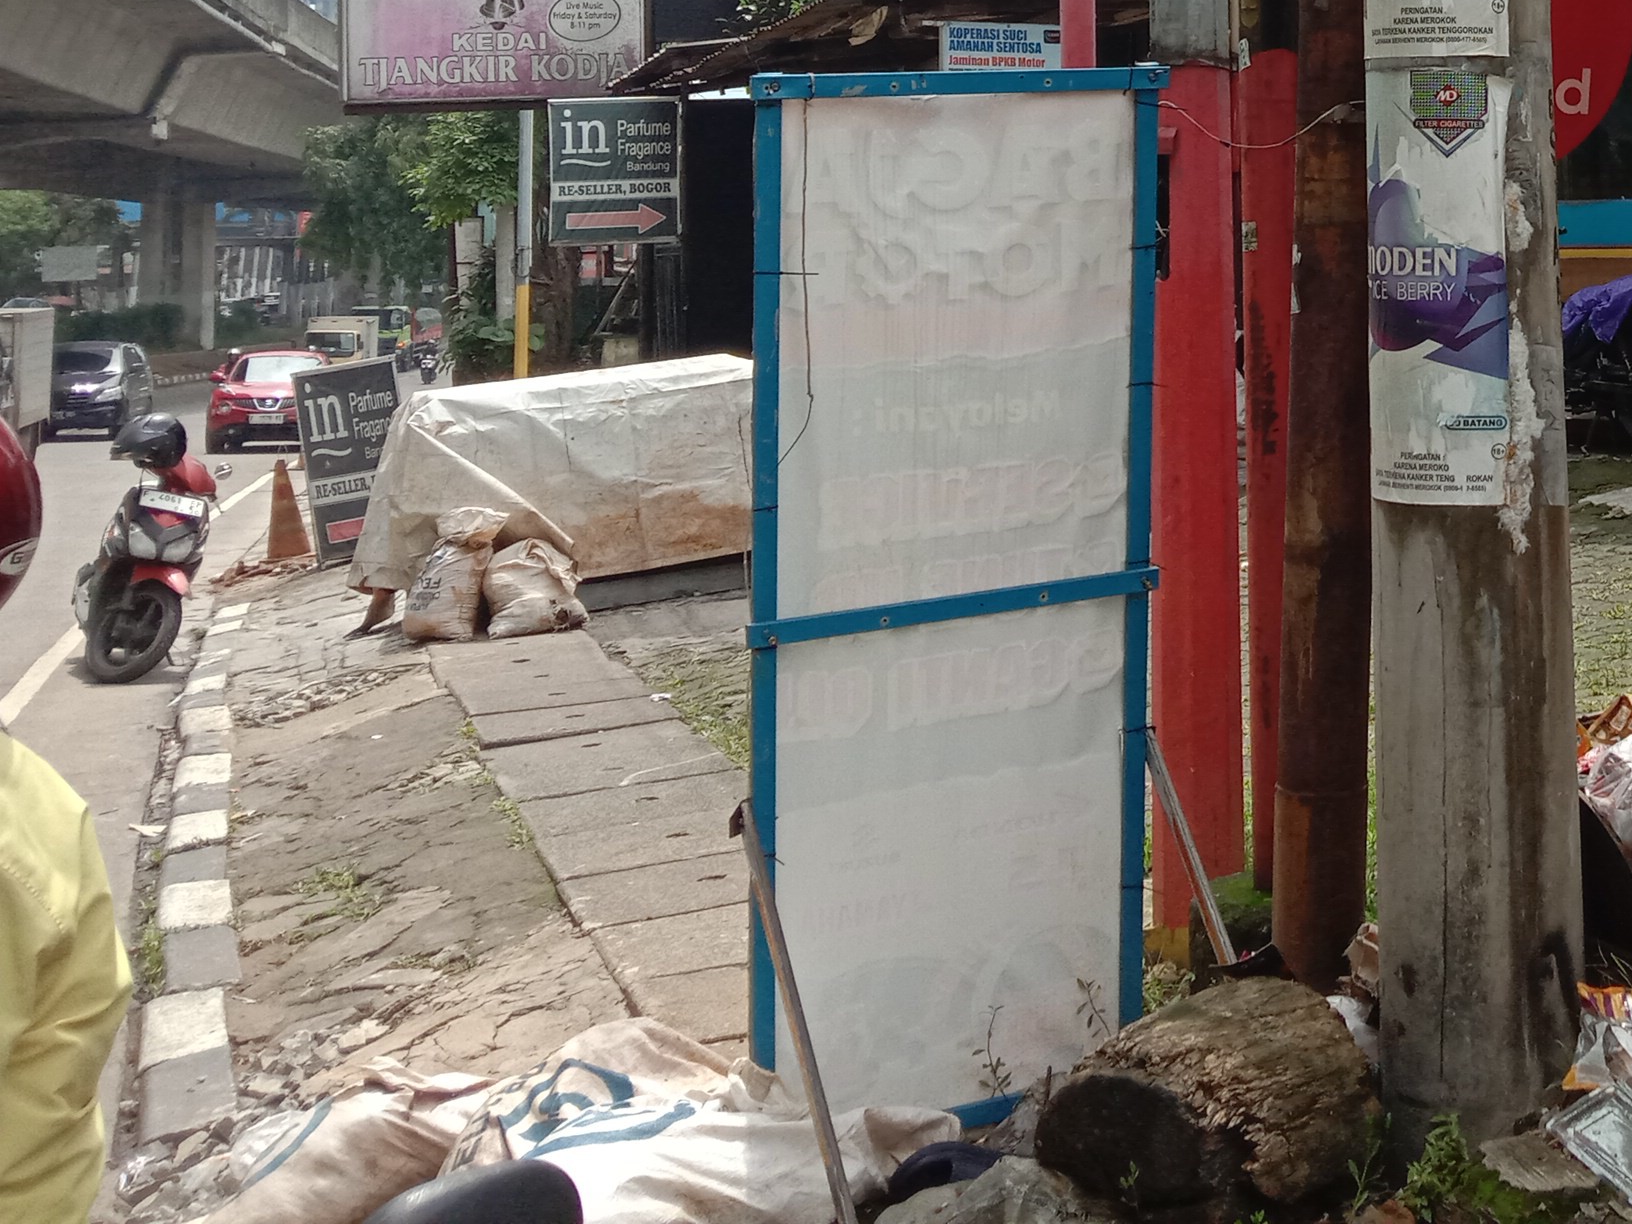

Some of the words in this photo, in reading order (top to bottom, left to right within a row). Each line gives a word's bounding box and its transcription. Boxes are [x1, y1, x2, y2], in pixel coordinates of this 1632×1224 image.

[566, 2, 580, 10] Live
[582, 2, 604, 10] Music
[1401, 6, 1443, 15] PERINGATAN
[553, 12, 575, 20] Friday
[577, 12, 583, 20] &
[584, 12, 617, 20] Saturday
[1393, 17, 1419, 25] KARENA
[1420, 16, 1456, 25] MEROKOK
[588, 22, 601, 30] pm
[1438, 26, 1493, 35] TENGGOROKAN
[949, 27, 1000, 40] KOPERASI
[1002, 29, 1027, 41] SUCI
[452, 31, 547, 52] KEDAI
[949, 39, 994, 52] AMANAH
[996, 41, 1042, 54] SENTOSA
[949, 55, 989, 66] Jaminan
[992, 56, 1016, 67] BPKB
[1018, 57, 1045, 68] Motor
[359, 54, 518, 93] TJANGKIR
[530, 53, 631, 88] KODJA
[1437, 90, 1458, 101] MD
[617, 119, 671, 136] Parfume
[1415, 120, 1438, 128] FILTER
[1440, 120, 1484, 128] CIGARETTES
[560, 109, 610, 154] in
[617, 139, 671, 159] Fragance
[627, 161, 670, 172] Bandung
[558, 183, 627, 196] RE-SELLER,
[629, 182, 671, 194] BOGOR
[1397, 282, 1456, 301] BERRY
[348, 389, 394, 414] Parfume
[304, 382, 349, 443] in
[353, 417, 391, 442] Fraganc
[1463, 419, 1503, 427] BATANG
[1394, 462, 1417, 470] KARENA
[1419, 463, 1449, 471] MEROKO
[1407, 473, 1433, 482] KANKER
[315, 477, 371, 499] RE-SELLER,
